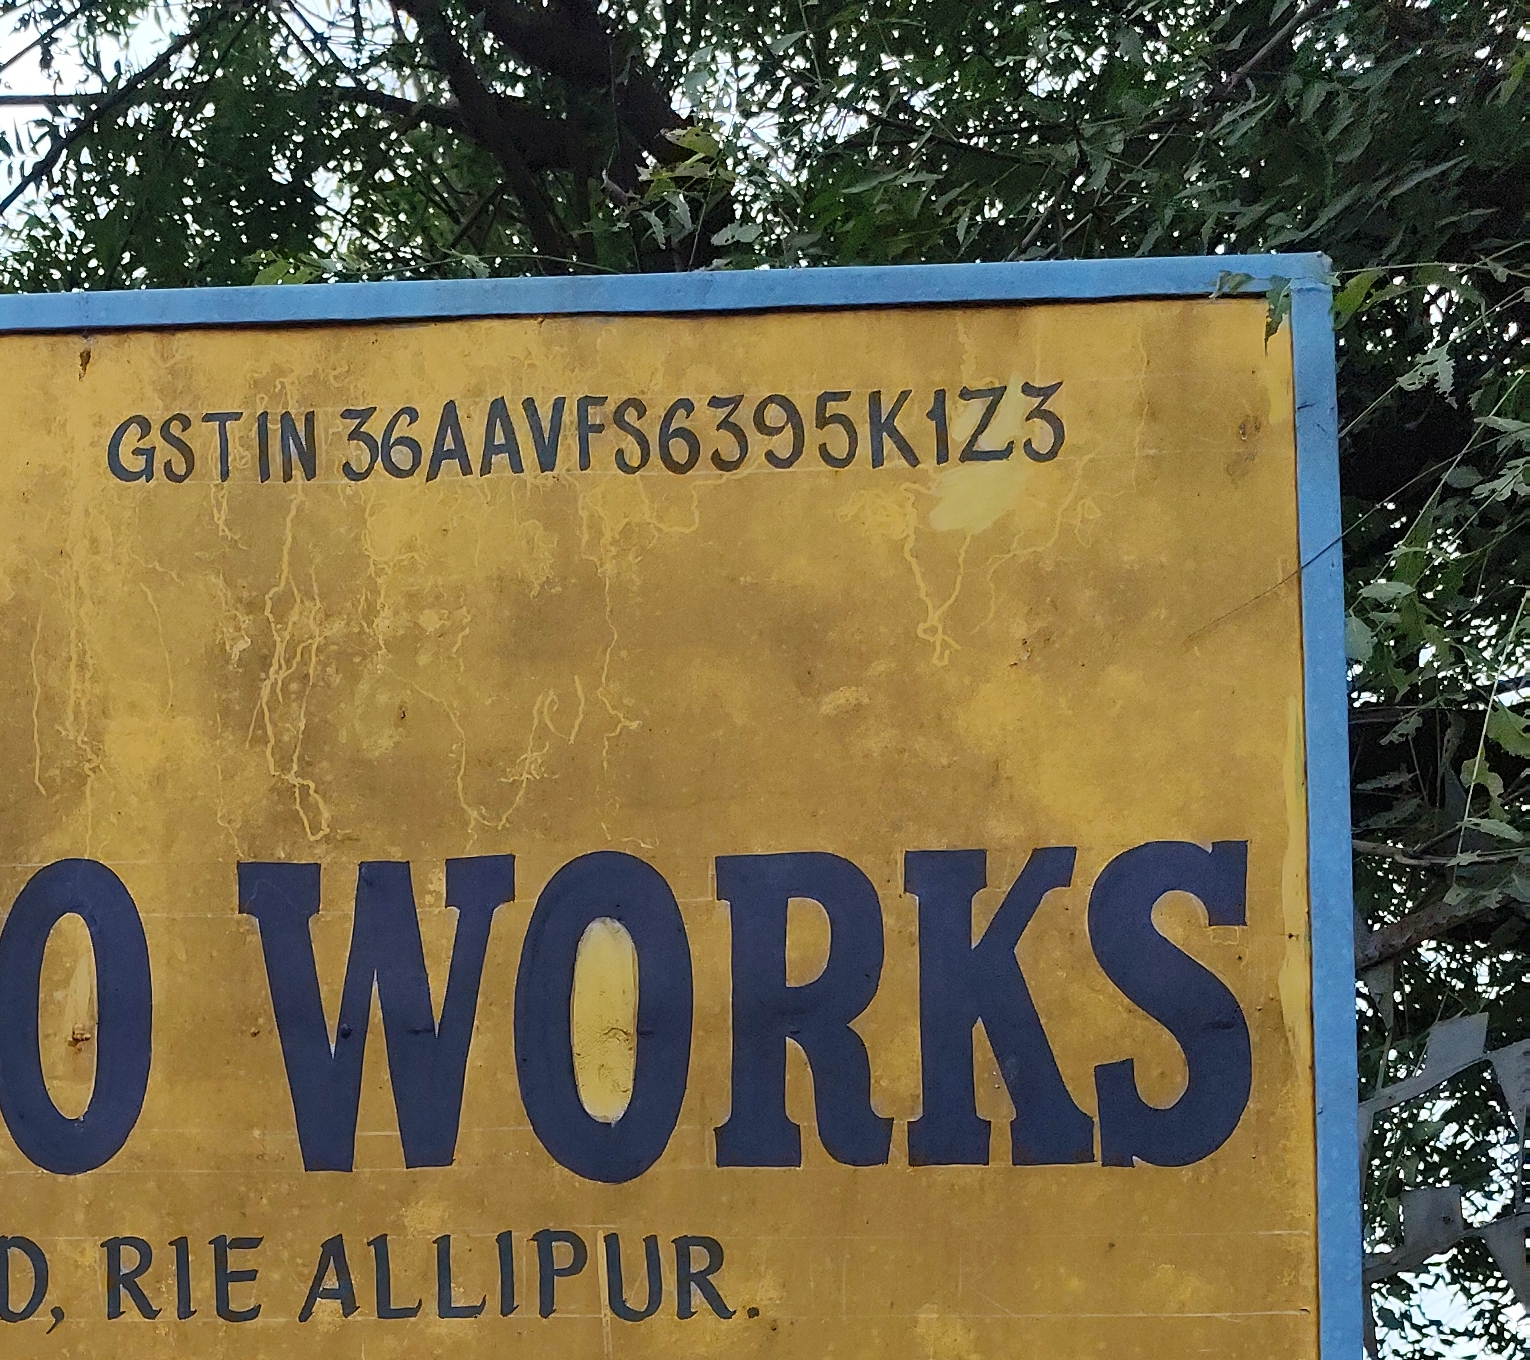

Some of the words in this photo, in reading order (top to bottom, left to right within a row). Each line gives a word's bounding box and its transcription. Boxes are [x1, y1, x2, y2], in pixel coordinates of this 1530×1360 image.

[108, 409, 317, 484] GSTIN
[341, 382, 1064, 483] 36AAVFS6395K1Z3
[237, 840, 1252, 1183] WORKS
[101, 1235, 264, 1322] RIE
[299, 1229, 760, 1323] ALLIPUR.
